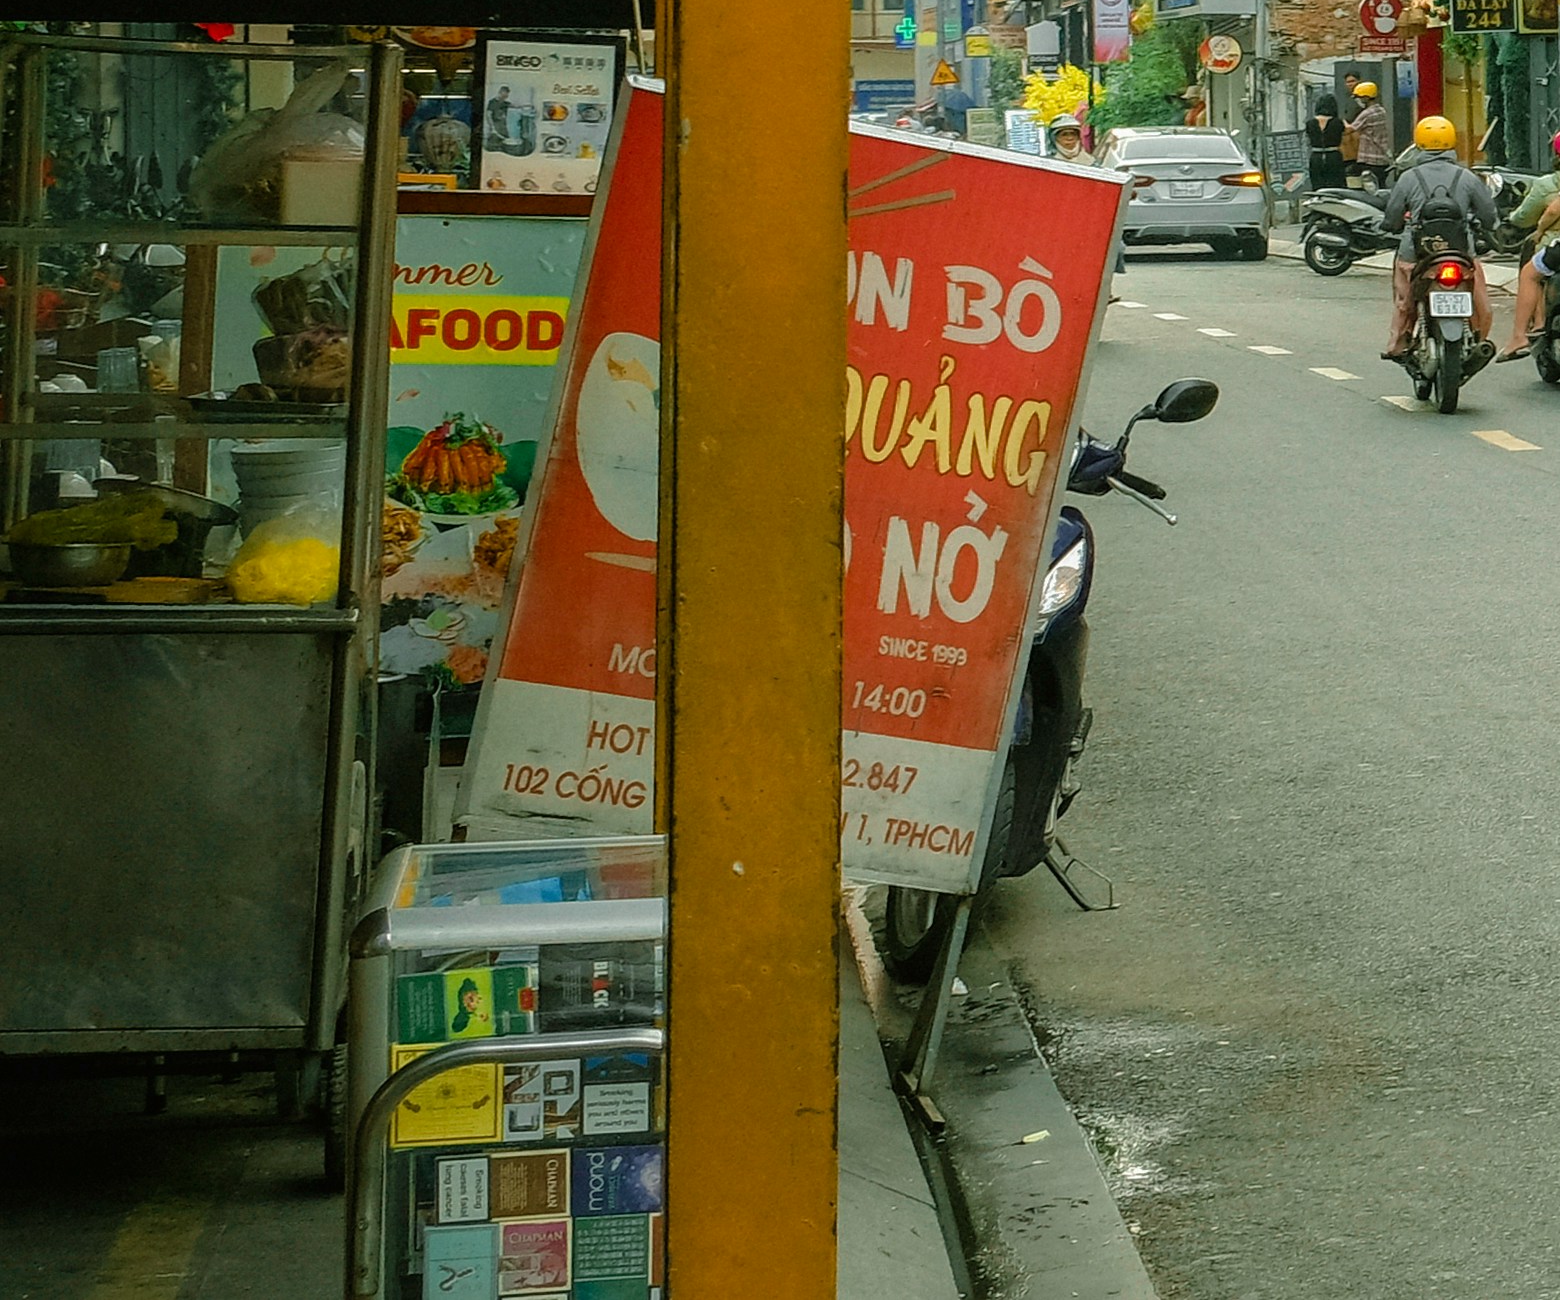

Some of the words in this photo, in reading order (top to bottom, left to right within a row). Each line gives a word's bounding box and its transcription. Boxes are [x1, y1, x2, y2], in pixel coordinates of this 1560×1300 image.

[1466, 12, 1502, 29] 244
[942, 255, 1062, 353] BÒ
[877, 489, 1009, 624] NỞ
[878, 634, 928, 662] SINCE
[931, 638, 968, 666] 1999
[851, 681, 927, 718] 14:00
[587, 719, 651, 756] HOT
[503, 763, 550, 795] 102
[555, 764, 647, 809] CỐNG
[885, 818, 976, 857] TPHCM
[546, 1158, 558, 1209] CHAPMAN
[508, 1230, 564, 1245] CHAPMAN
